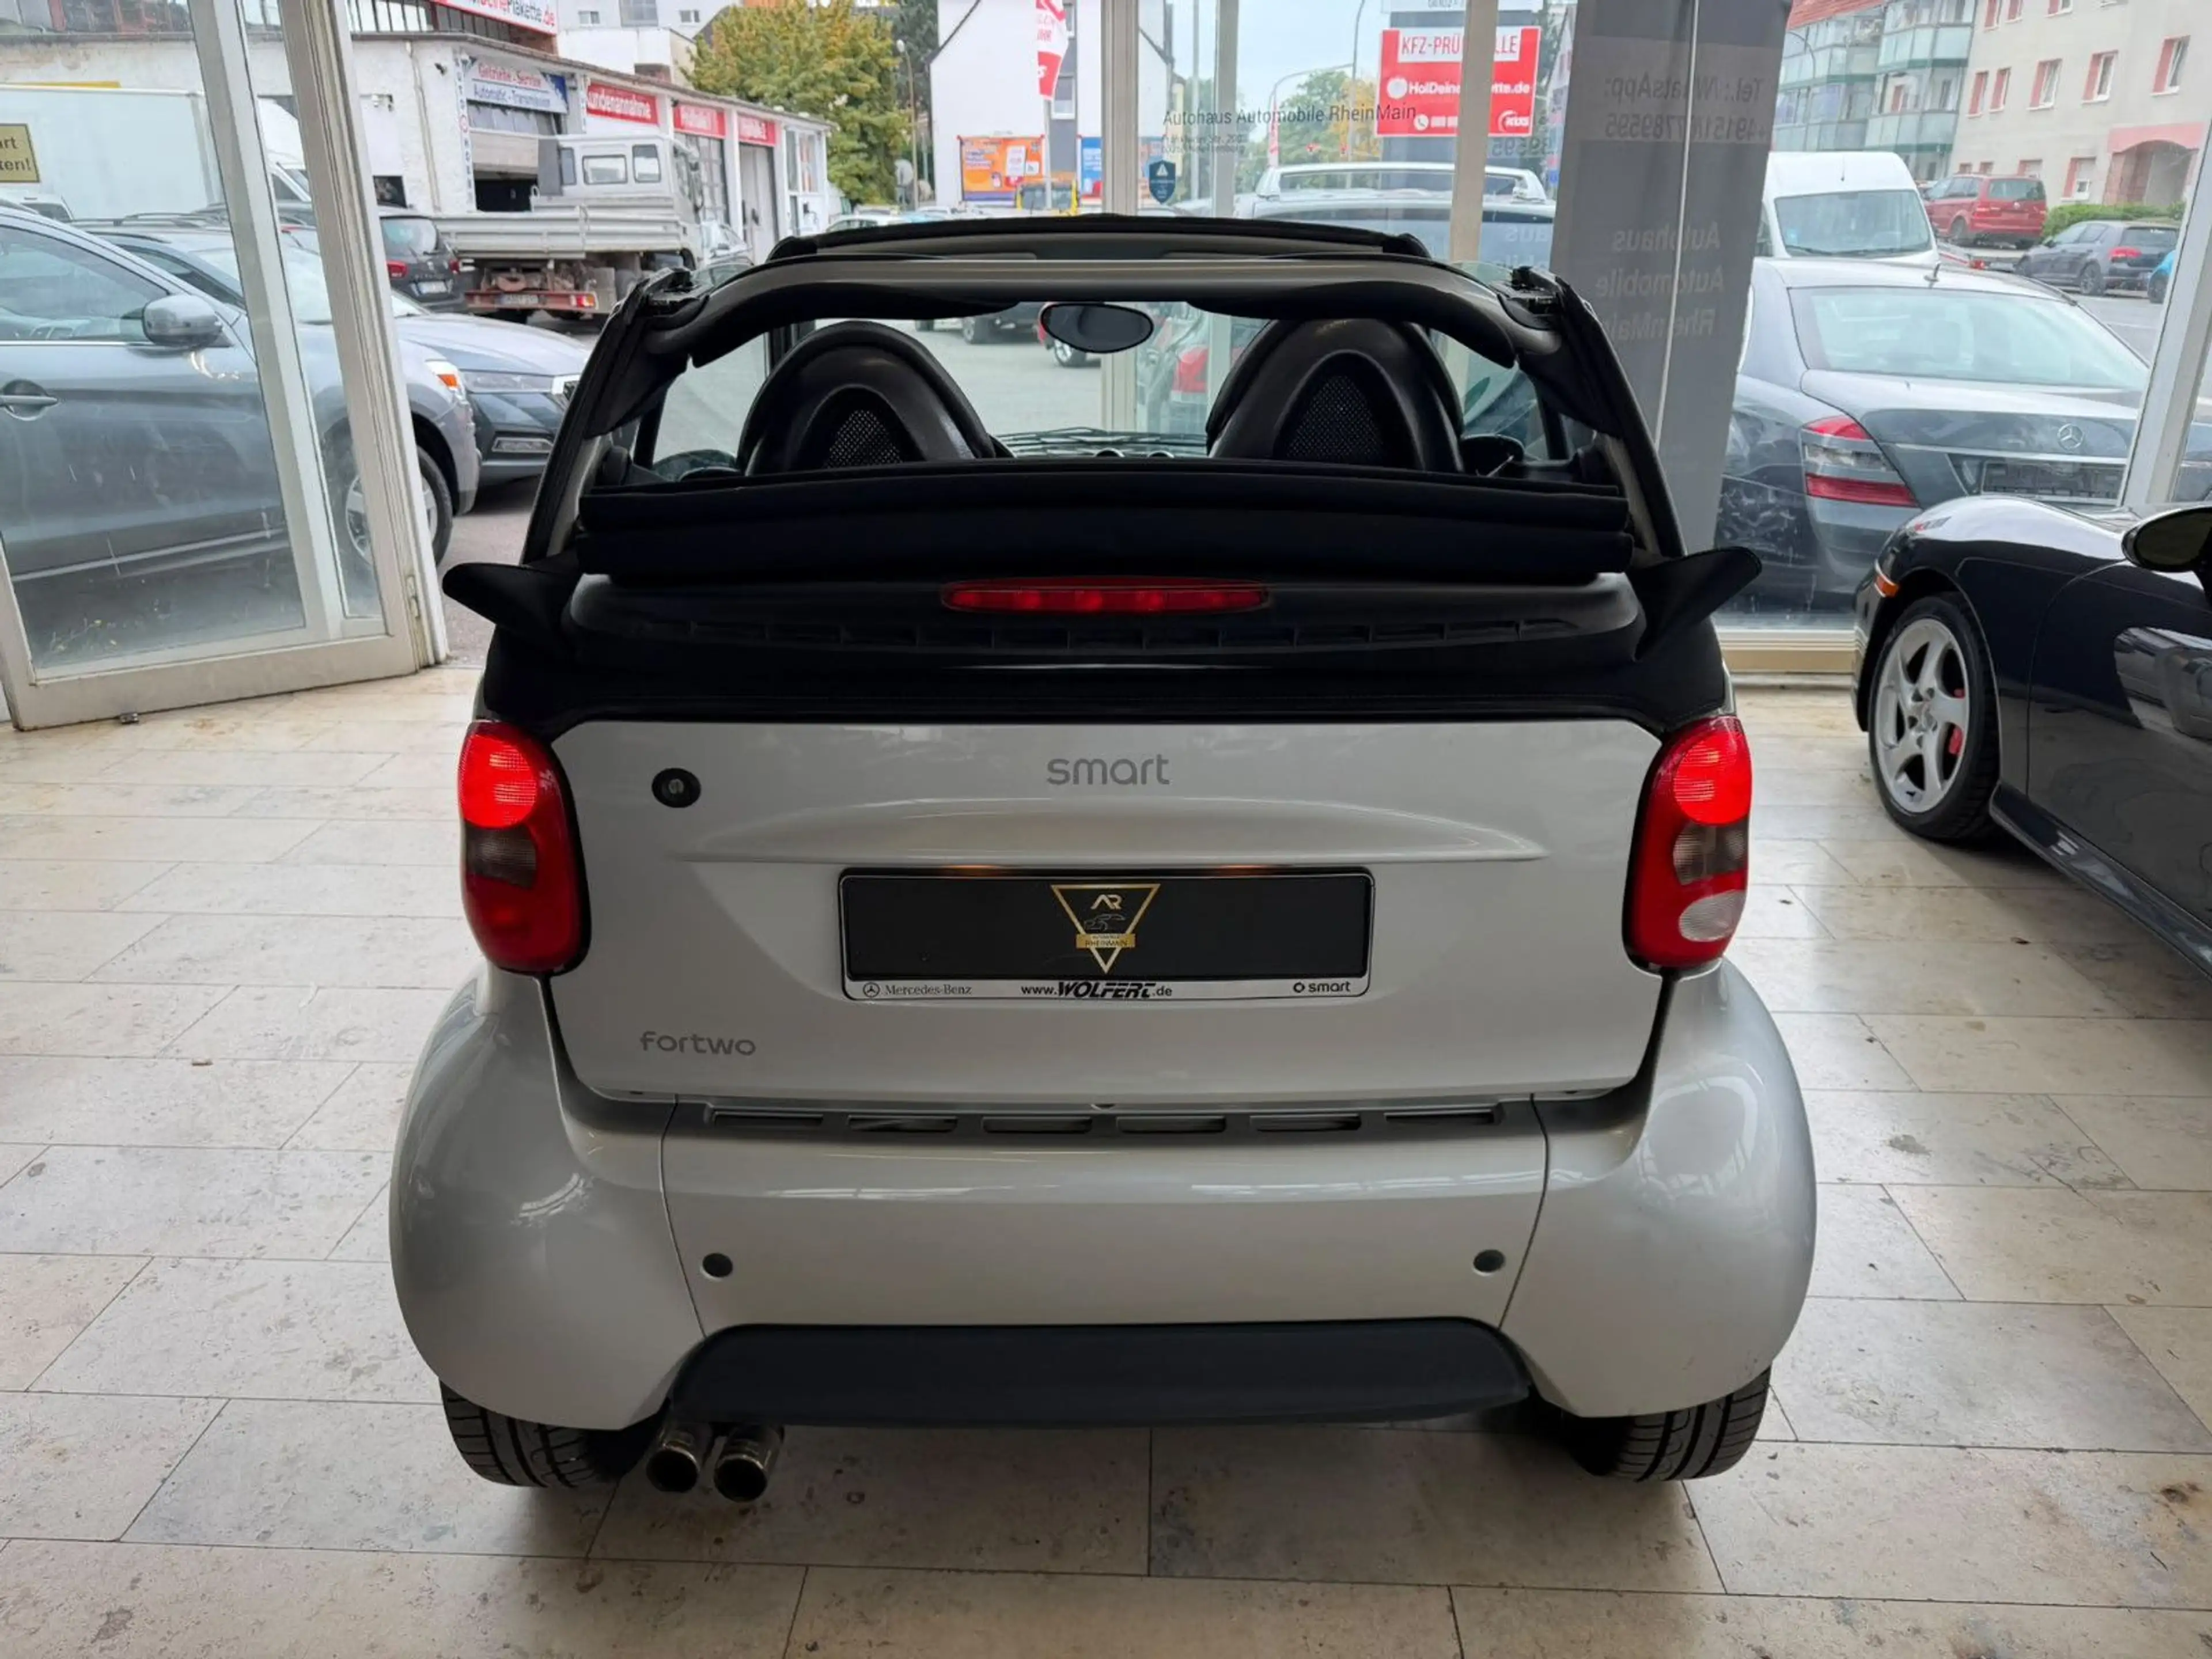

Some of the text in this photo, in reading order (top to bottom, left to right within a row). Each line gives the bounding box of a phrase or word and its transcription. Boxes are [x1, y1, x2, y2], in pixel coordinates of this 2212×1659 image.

[1162, 110, 1232, 126] Autohaus
[1236, 105, 1324, 124] Automobile
[1330, 102, 1416, 122] RheinMain
[1047, 753, 1170, 785] smart
[885, 981, 1351, 999] Mercedes-Benz www.WOLFERT.de smart
[639, 1031, 756, 1056] fortwo
